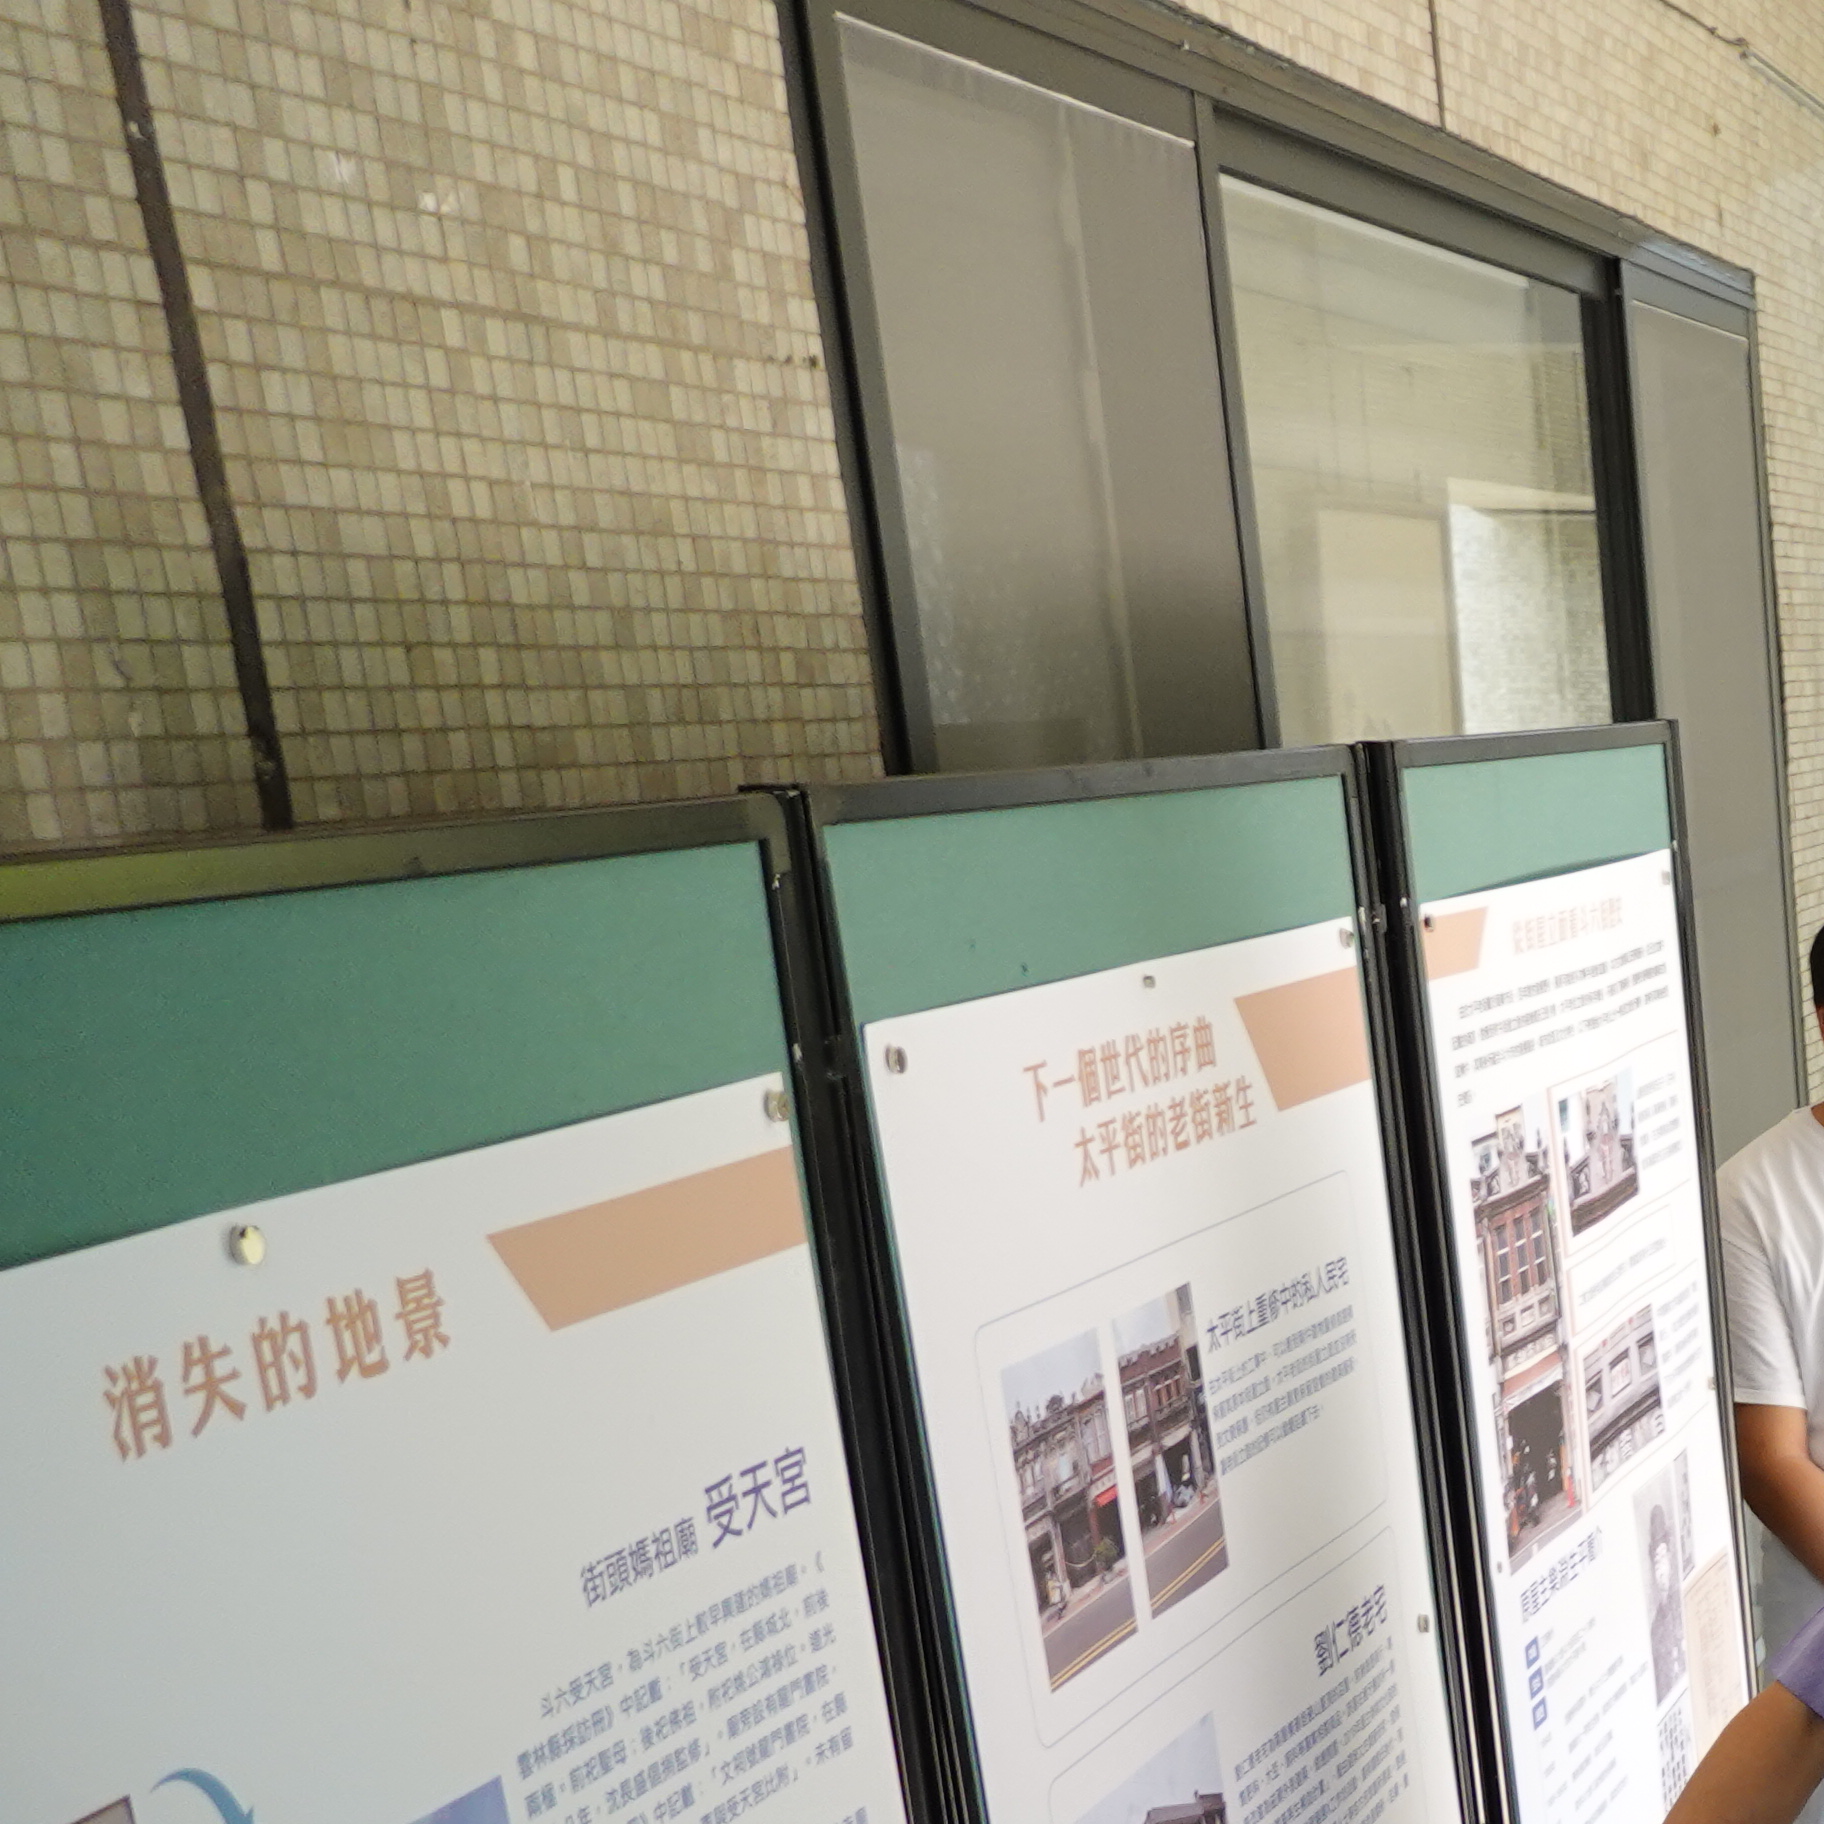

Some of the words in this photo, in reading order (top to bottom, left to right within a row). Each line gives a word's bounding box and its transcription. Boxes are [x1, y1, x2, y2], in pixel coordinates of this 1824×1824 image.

[1023, 1020, 1218, 1124] 下一個世代的序曲
[1073, 1076, 1258, 1189] 太平街的老街新生
[100, 1268, 452, 1467] 消失的地景
[579, 1515, 699, 1607] 街頭媽祖廟
[705, 1446, 813, 1550] 受天宮
